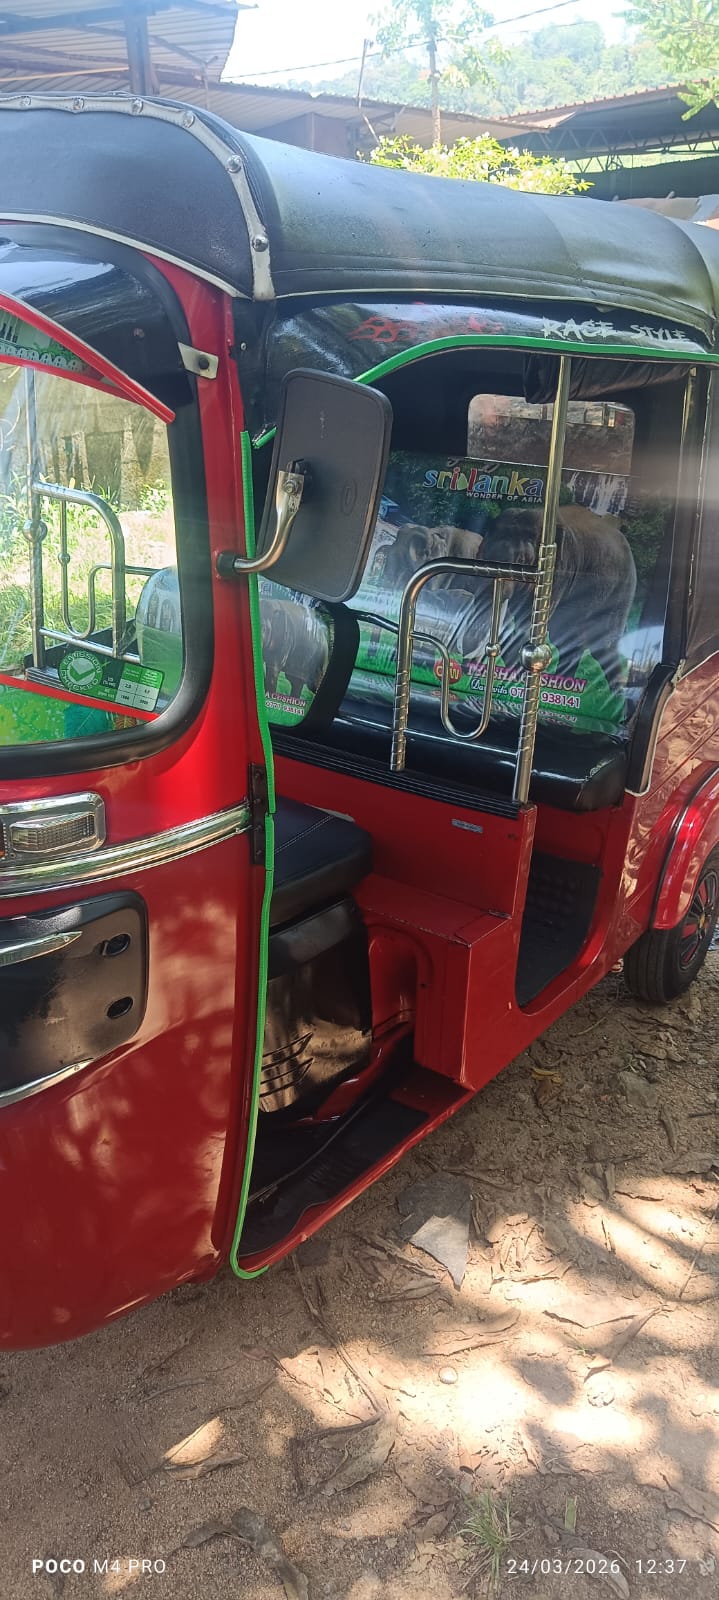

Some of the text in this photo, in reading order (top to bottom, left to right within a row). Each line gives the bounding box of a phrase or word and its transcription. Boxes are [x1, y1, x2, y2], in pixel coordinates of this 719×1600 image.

[630, 324, 690, 341] STYLE
[467, 491, 503, 500] WONDER
[521, 673, 586, 693] CSHION
[272, 693, 305, 706] CUSHION
[541, 691, 580, 708] 938141
